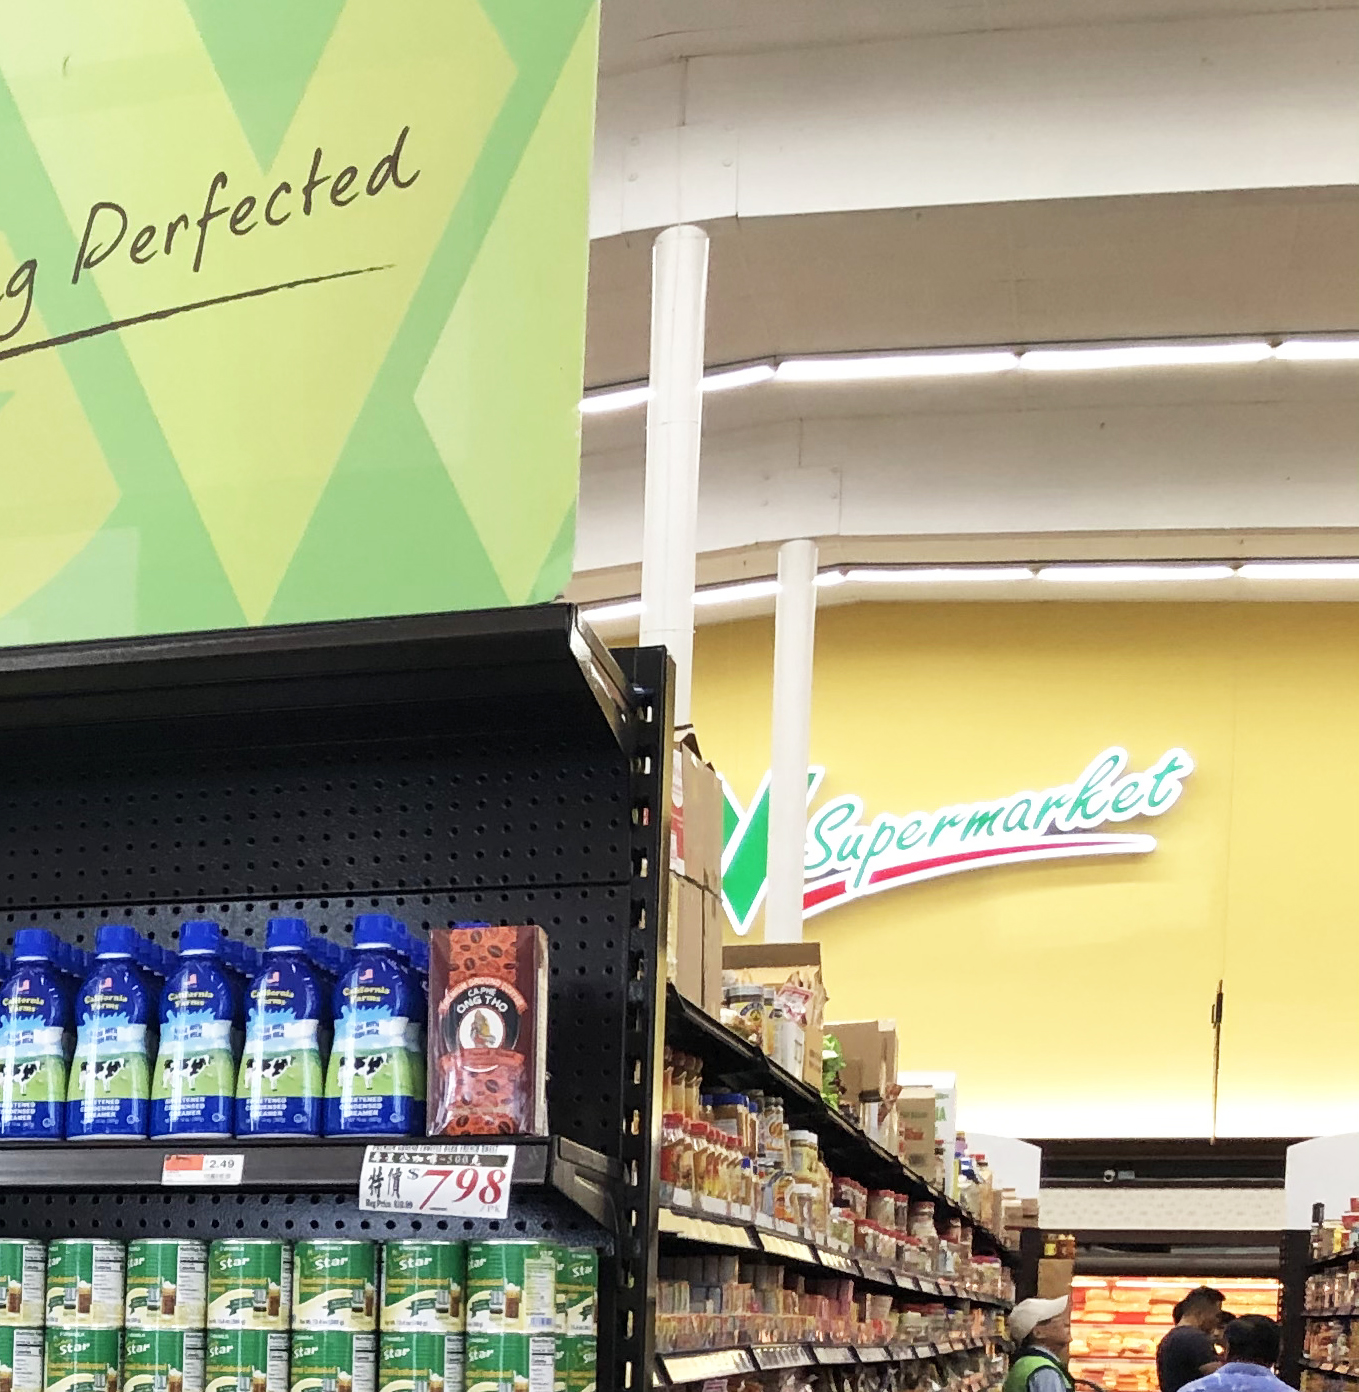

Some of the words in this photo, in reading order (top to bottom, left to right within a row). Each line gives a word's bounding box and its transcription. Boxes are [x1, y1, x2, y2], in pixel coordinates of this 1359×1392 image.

[70, 127, 421, 285] Perfected
[804, 754, 1185, 889] Supermarket
[457, 996, 481, 1013] ONG
[485, 996, 508, 1013] THO
